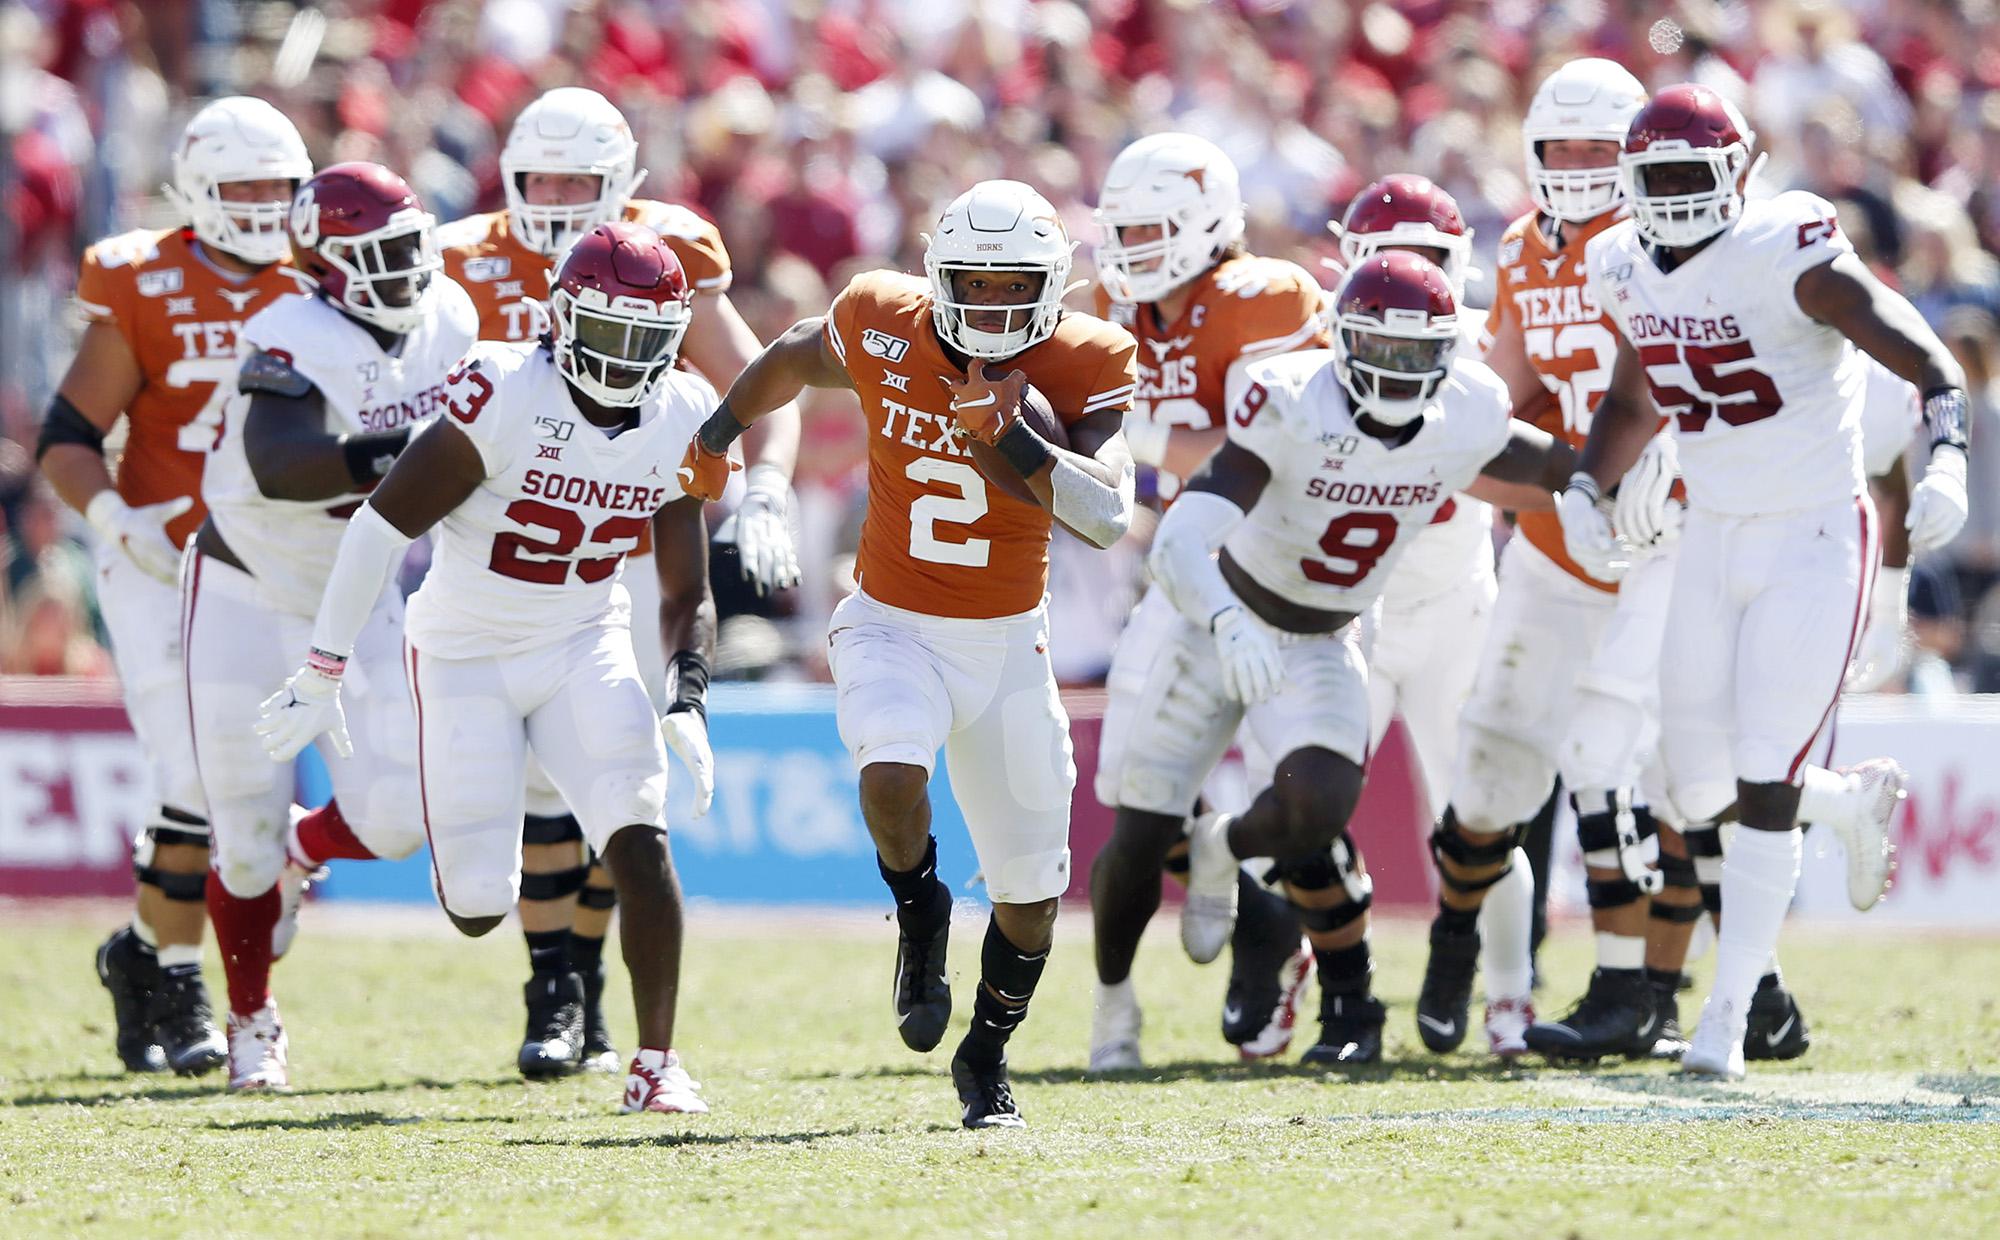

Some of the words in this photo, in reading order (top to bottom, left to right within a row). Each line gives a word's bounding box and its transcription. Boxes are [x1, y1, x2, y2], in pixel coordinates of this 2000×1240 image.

[976, 243, 1003, 252] HORNS
[864, 330, 908, 361] 150
[1638, 339, 1784, 432] 55
[881, 397, 973, 457] TEX
[521, 469, 665, 512] SOONERS
[905, 456, 991, 567] 2
[1306, 478, 1442, 506] SOONERS
[488, 499, 653, 585] 23
[1300, 511, 1399, 588] 9
